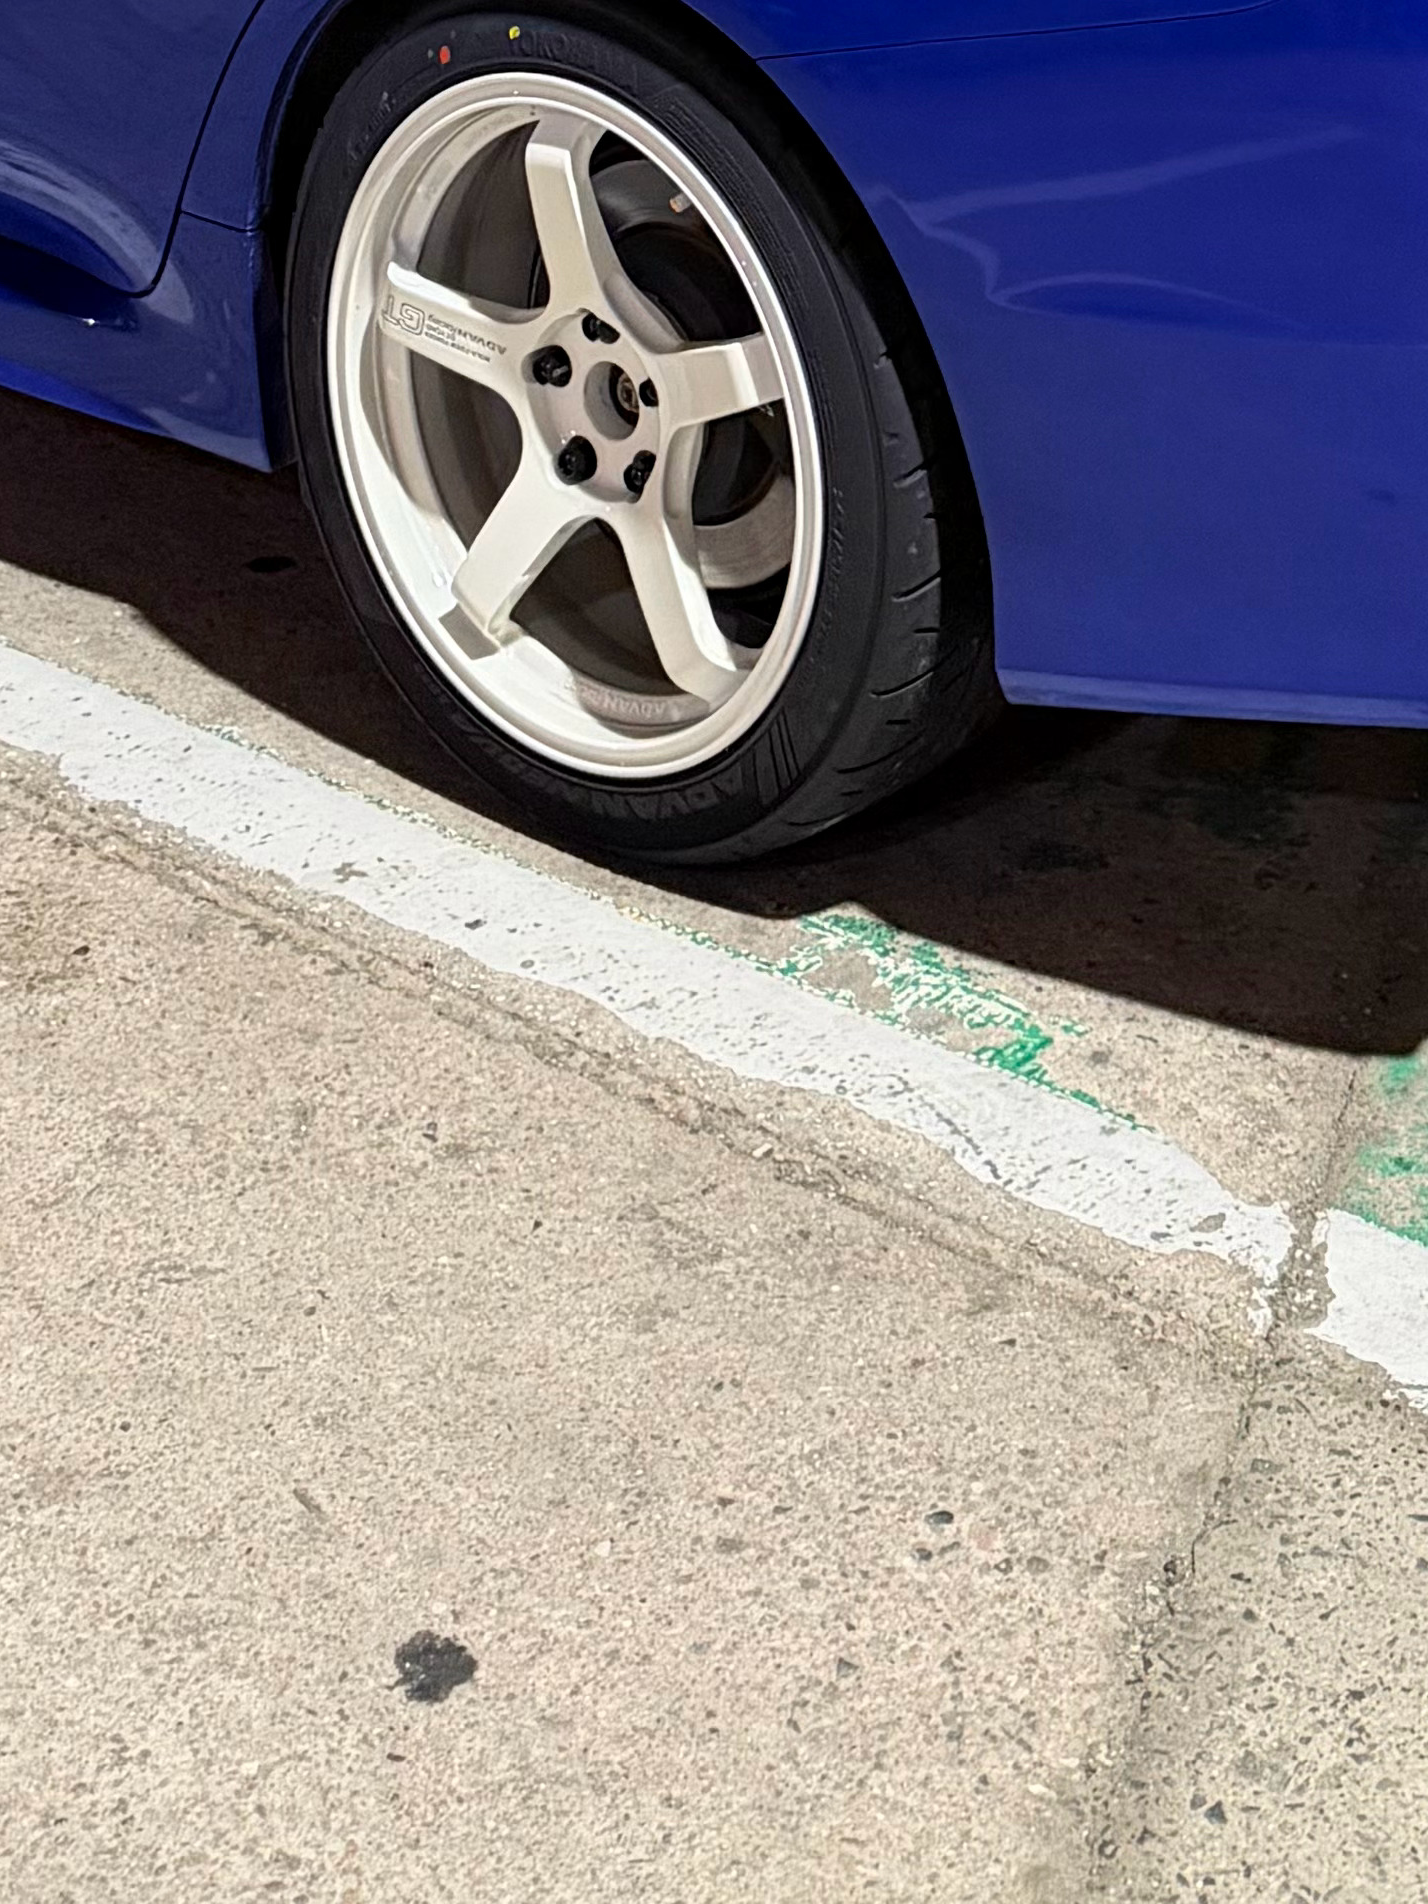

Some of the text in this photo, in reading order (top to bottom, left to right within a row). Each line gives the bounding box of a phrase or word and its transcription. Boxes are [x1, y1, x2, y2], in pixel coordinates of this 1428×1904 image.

[381, 295, 426, 336] GT
[456, 327, 508, 356] ADVAN
[603, 693, 667, 720] ADVAN
[590, 763, 747, 822] ADVAN
